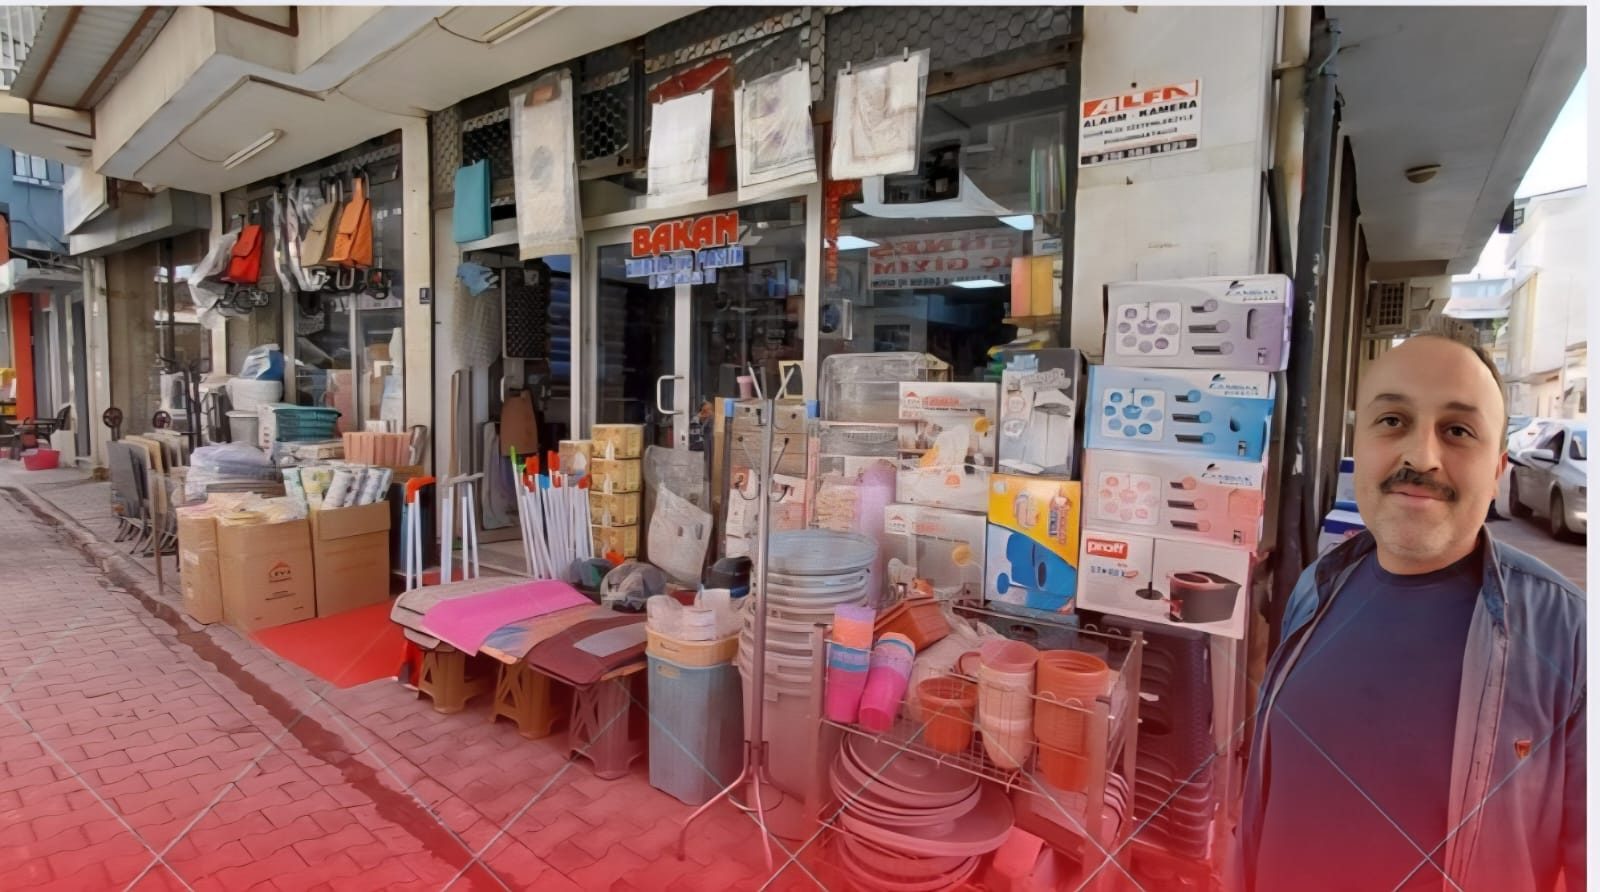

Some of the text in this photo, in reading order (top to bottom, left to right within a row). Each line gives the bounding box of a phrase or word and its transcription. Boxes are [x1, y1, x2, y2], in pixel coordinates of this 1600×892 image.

[1084, 100, 1197, 128] ALARM KAMERA
[631, 210, 739, 258] BAKAN
